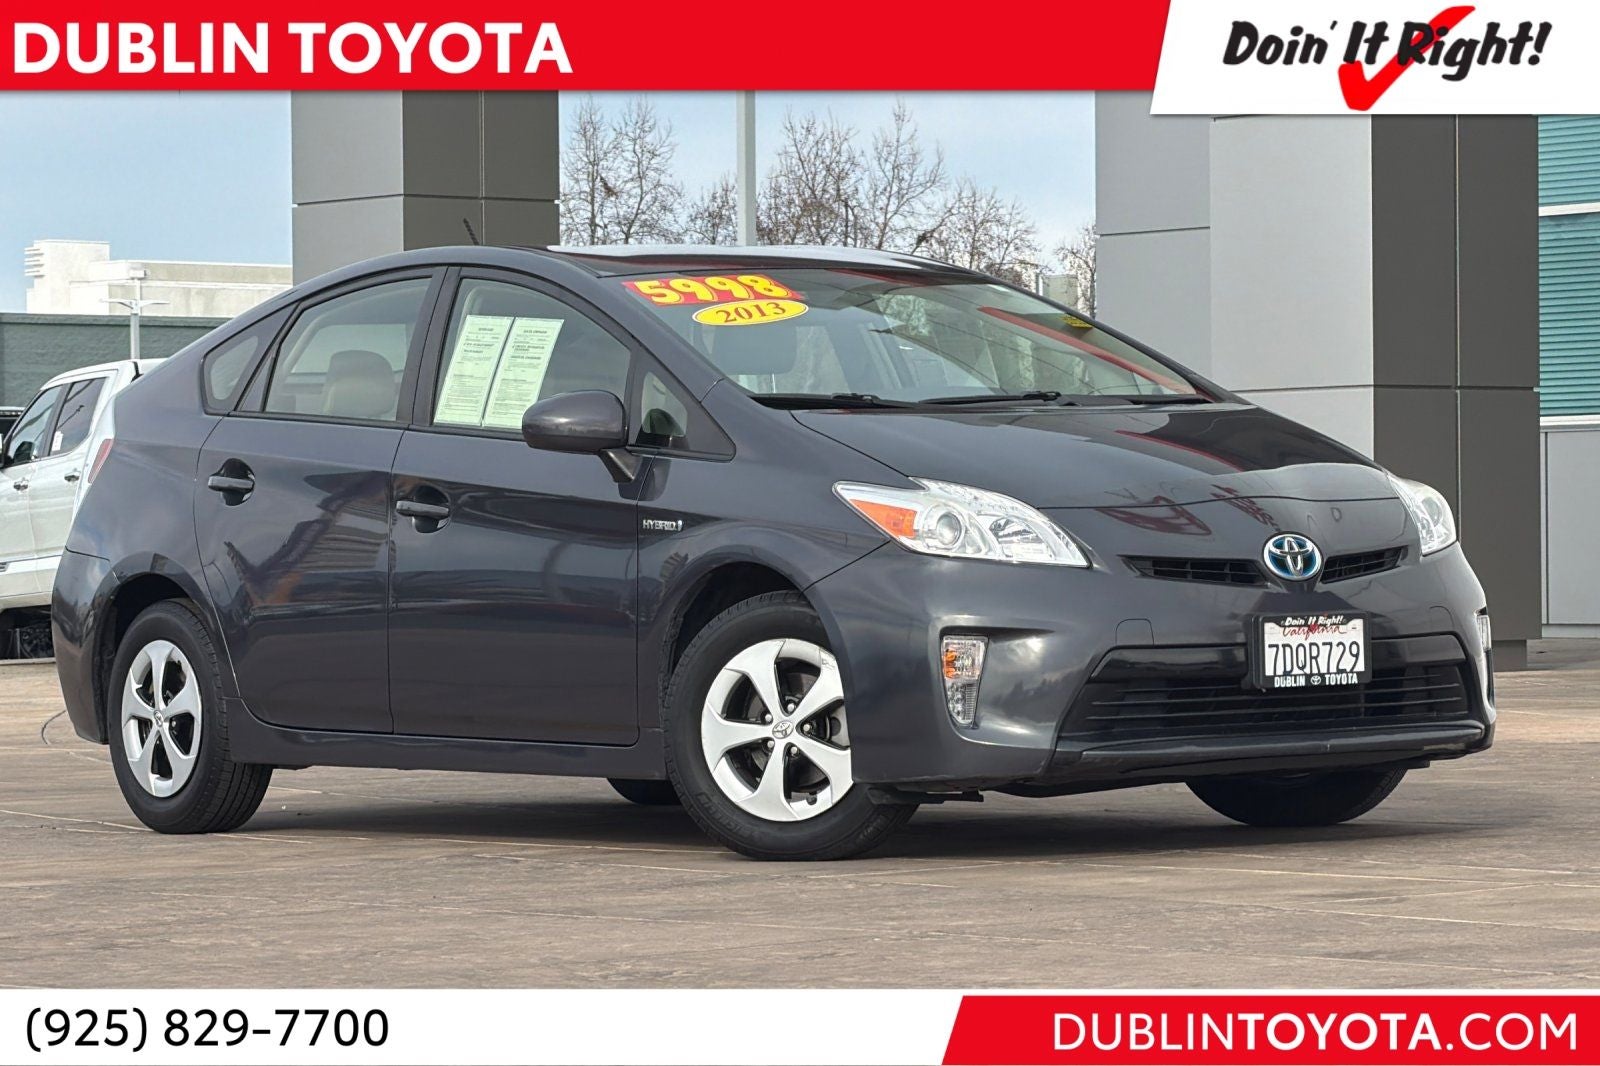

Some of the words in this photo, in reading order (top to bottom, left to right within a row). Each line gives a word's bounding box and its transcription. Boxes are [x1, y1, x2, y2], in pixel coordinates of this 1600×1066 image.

[634, 274, 790, 304] 5998
[715, 301, 787, 324] 2013
[642, 519, 676, 531] HYBRID
[1307, 615, 1318, 625] It
[1317, 614, 1345, 627] Right!
[1267, 640, 1361, 676] 7DQR729
[1274, 675, 1306, 688] DUBLIN
[1324, 672, 1358, 686] TOYOTA
